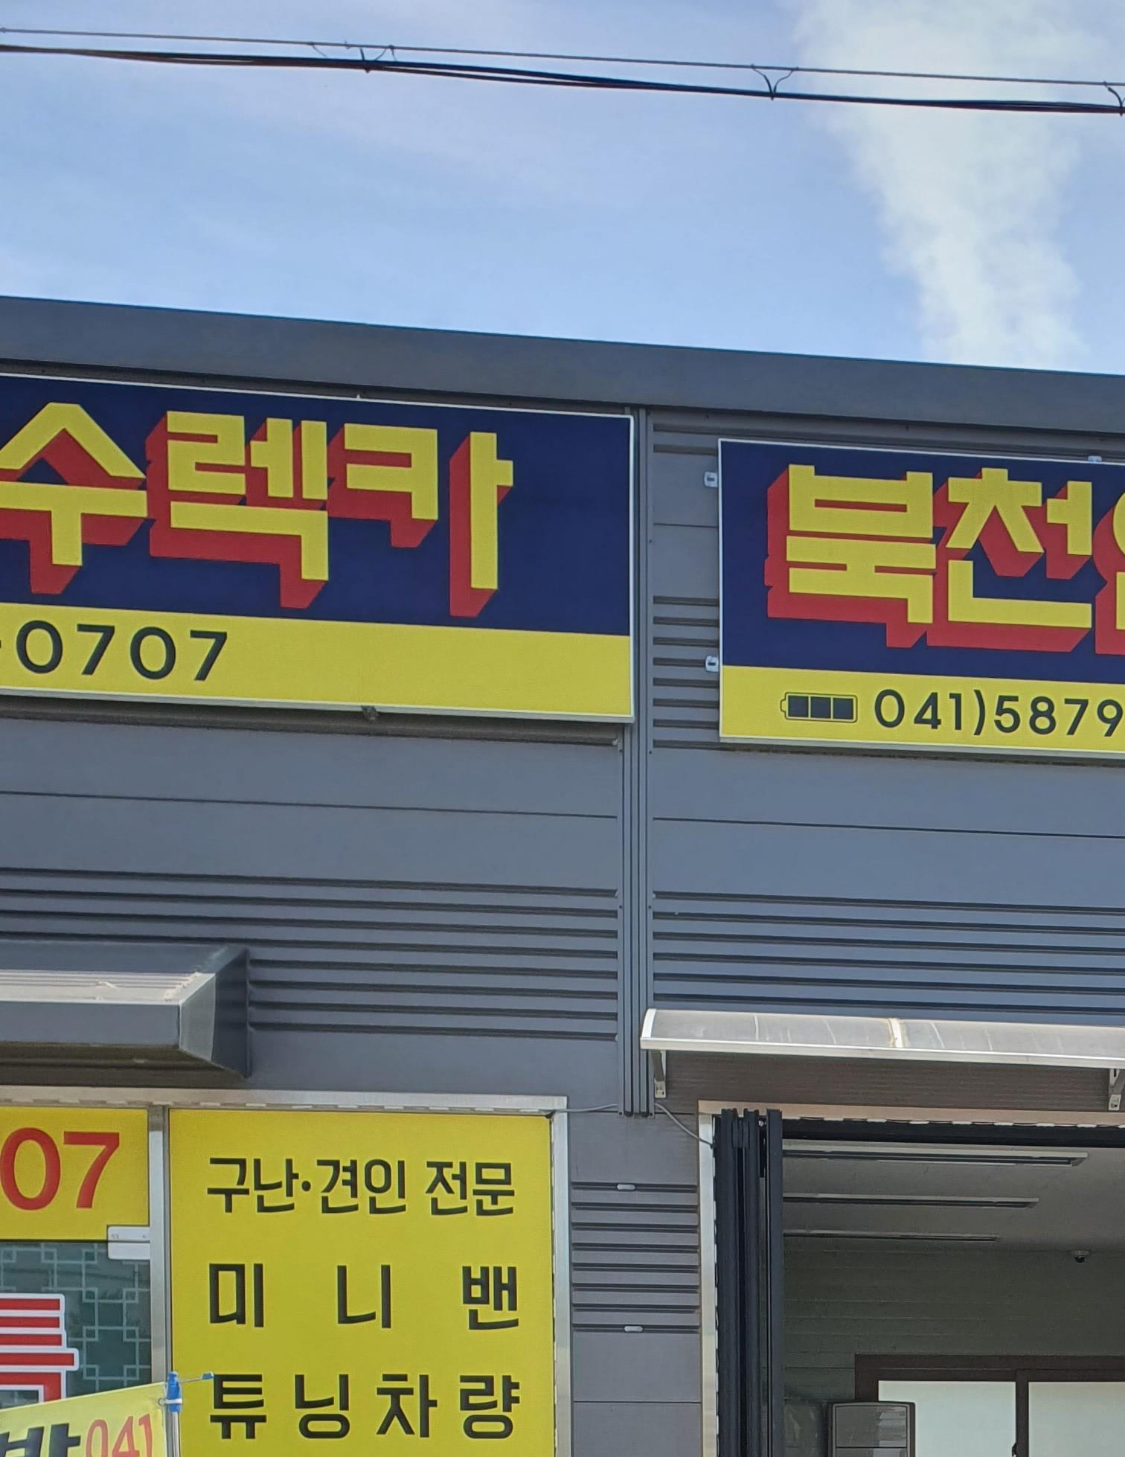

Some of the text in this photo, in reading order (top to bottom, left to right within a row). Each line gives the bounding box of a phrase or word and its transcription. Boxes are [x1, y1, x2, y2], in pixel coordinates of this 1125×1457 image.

[0, 402, 513, 617] 수렉카
[0, 618, 229, 682] 0707
[424, 1160, 516, 1218] 전문
[209, 1372, 521, 1441] 튜닝차량
